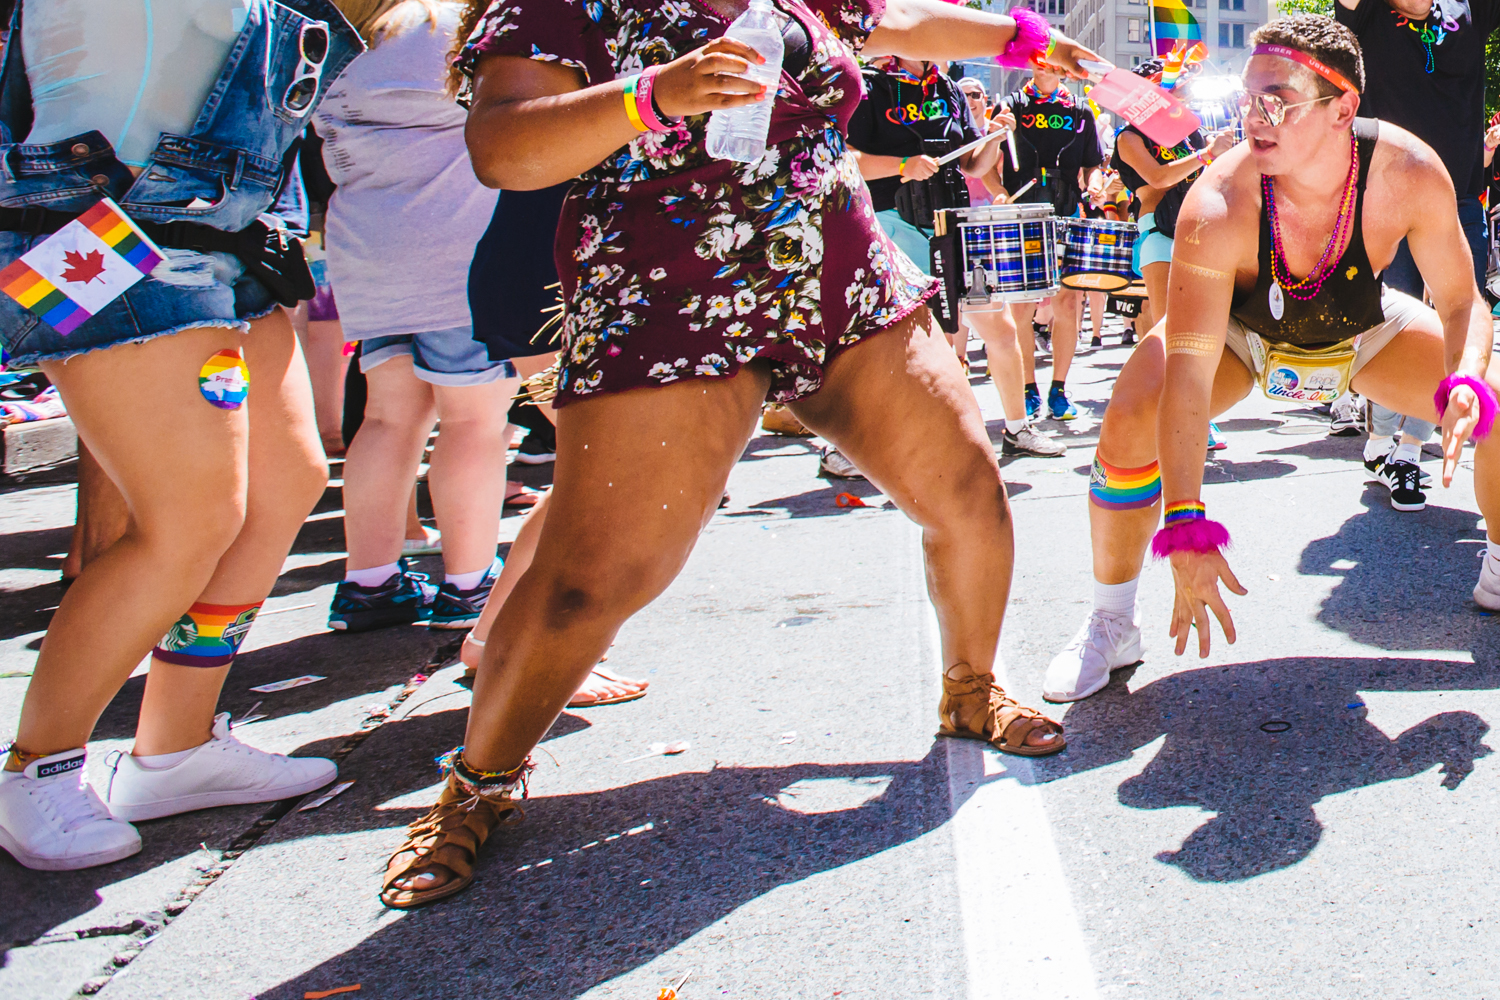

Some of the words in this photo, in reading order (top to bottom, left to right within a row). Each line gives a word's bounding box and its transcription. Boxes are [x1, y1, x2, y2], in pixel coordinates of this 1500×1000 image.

[1268, 47, 1292, 55] UBER
[1309, 59, 1331, 75] UBER
[1122, 87, 1160, 121] EQUALITY
[933, 249, 944, 273] VIC
[1074, 274, 1101, 285] Pearl
[1115, 300, 1134, 314] VIC
[1309, 376, 1338, 385] PRIDE
[1268, 385, 1305, 399] Uncle
[1307, 391, 1337, 400] Ike's
[41, 759, 84, 775] adidas
